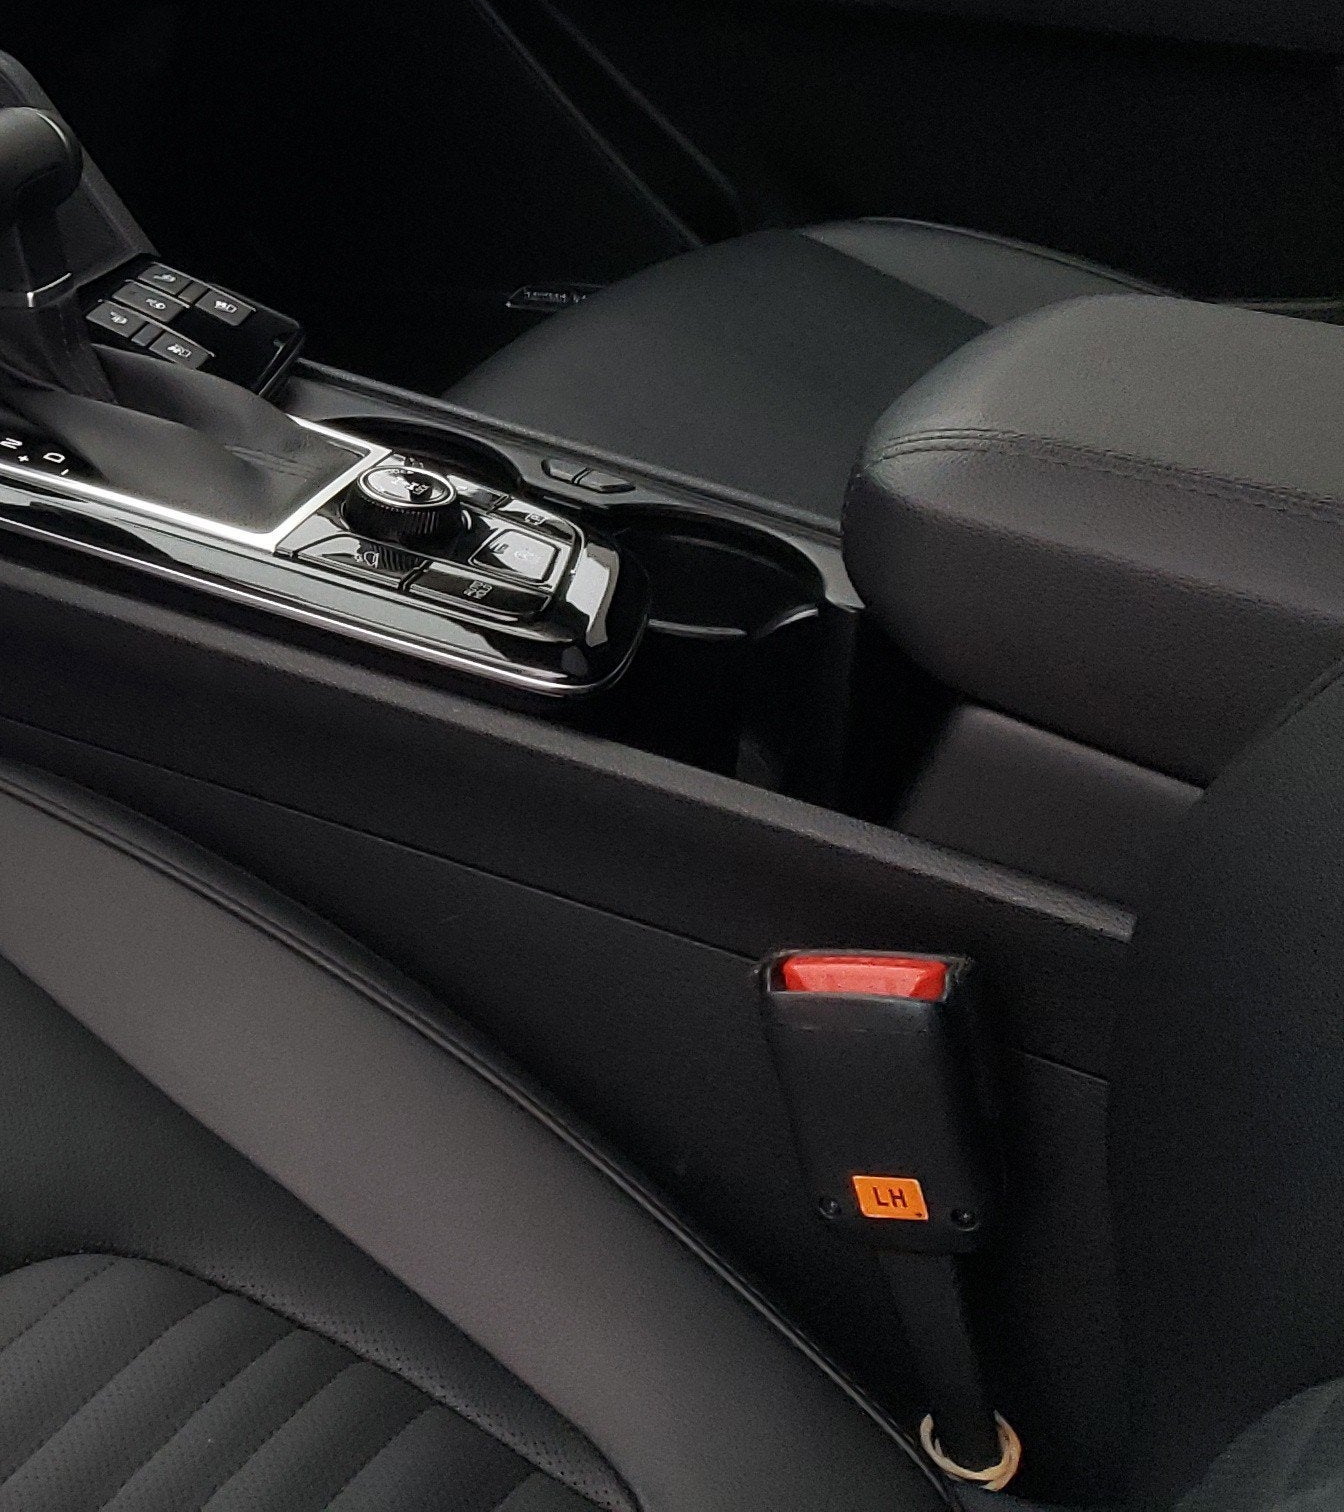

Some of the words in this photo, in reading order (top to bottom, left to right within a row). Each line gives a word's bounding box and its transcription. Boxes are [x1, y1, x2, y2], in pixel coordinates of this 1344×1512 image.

[0, 437, 23, 450] N
[43, 452, 66, 464] D
[873, 1186, 908, 1207] LH
